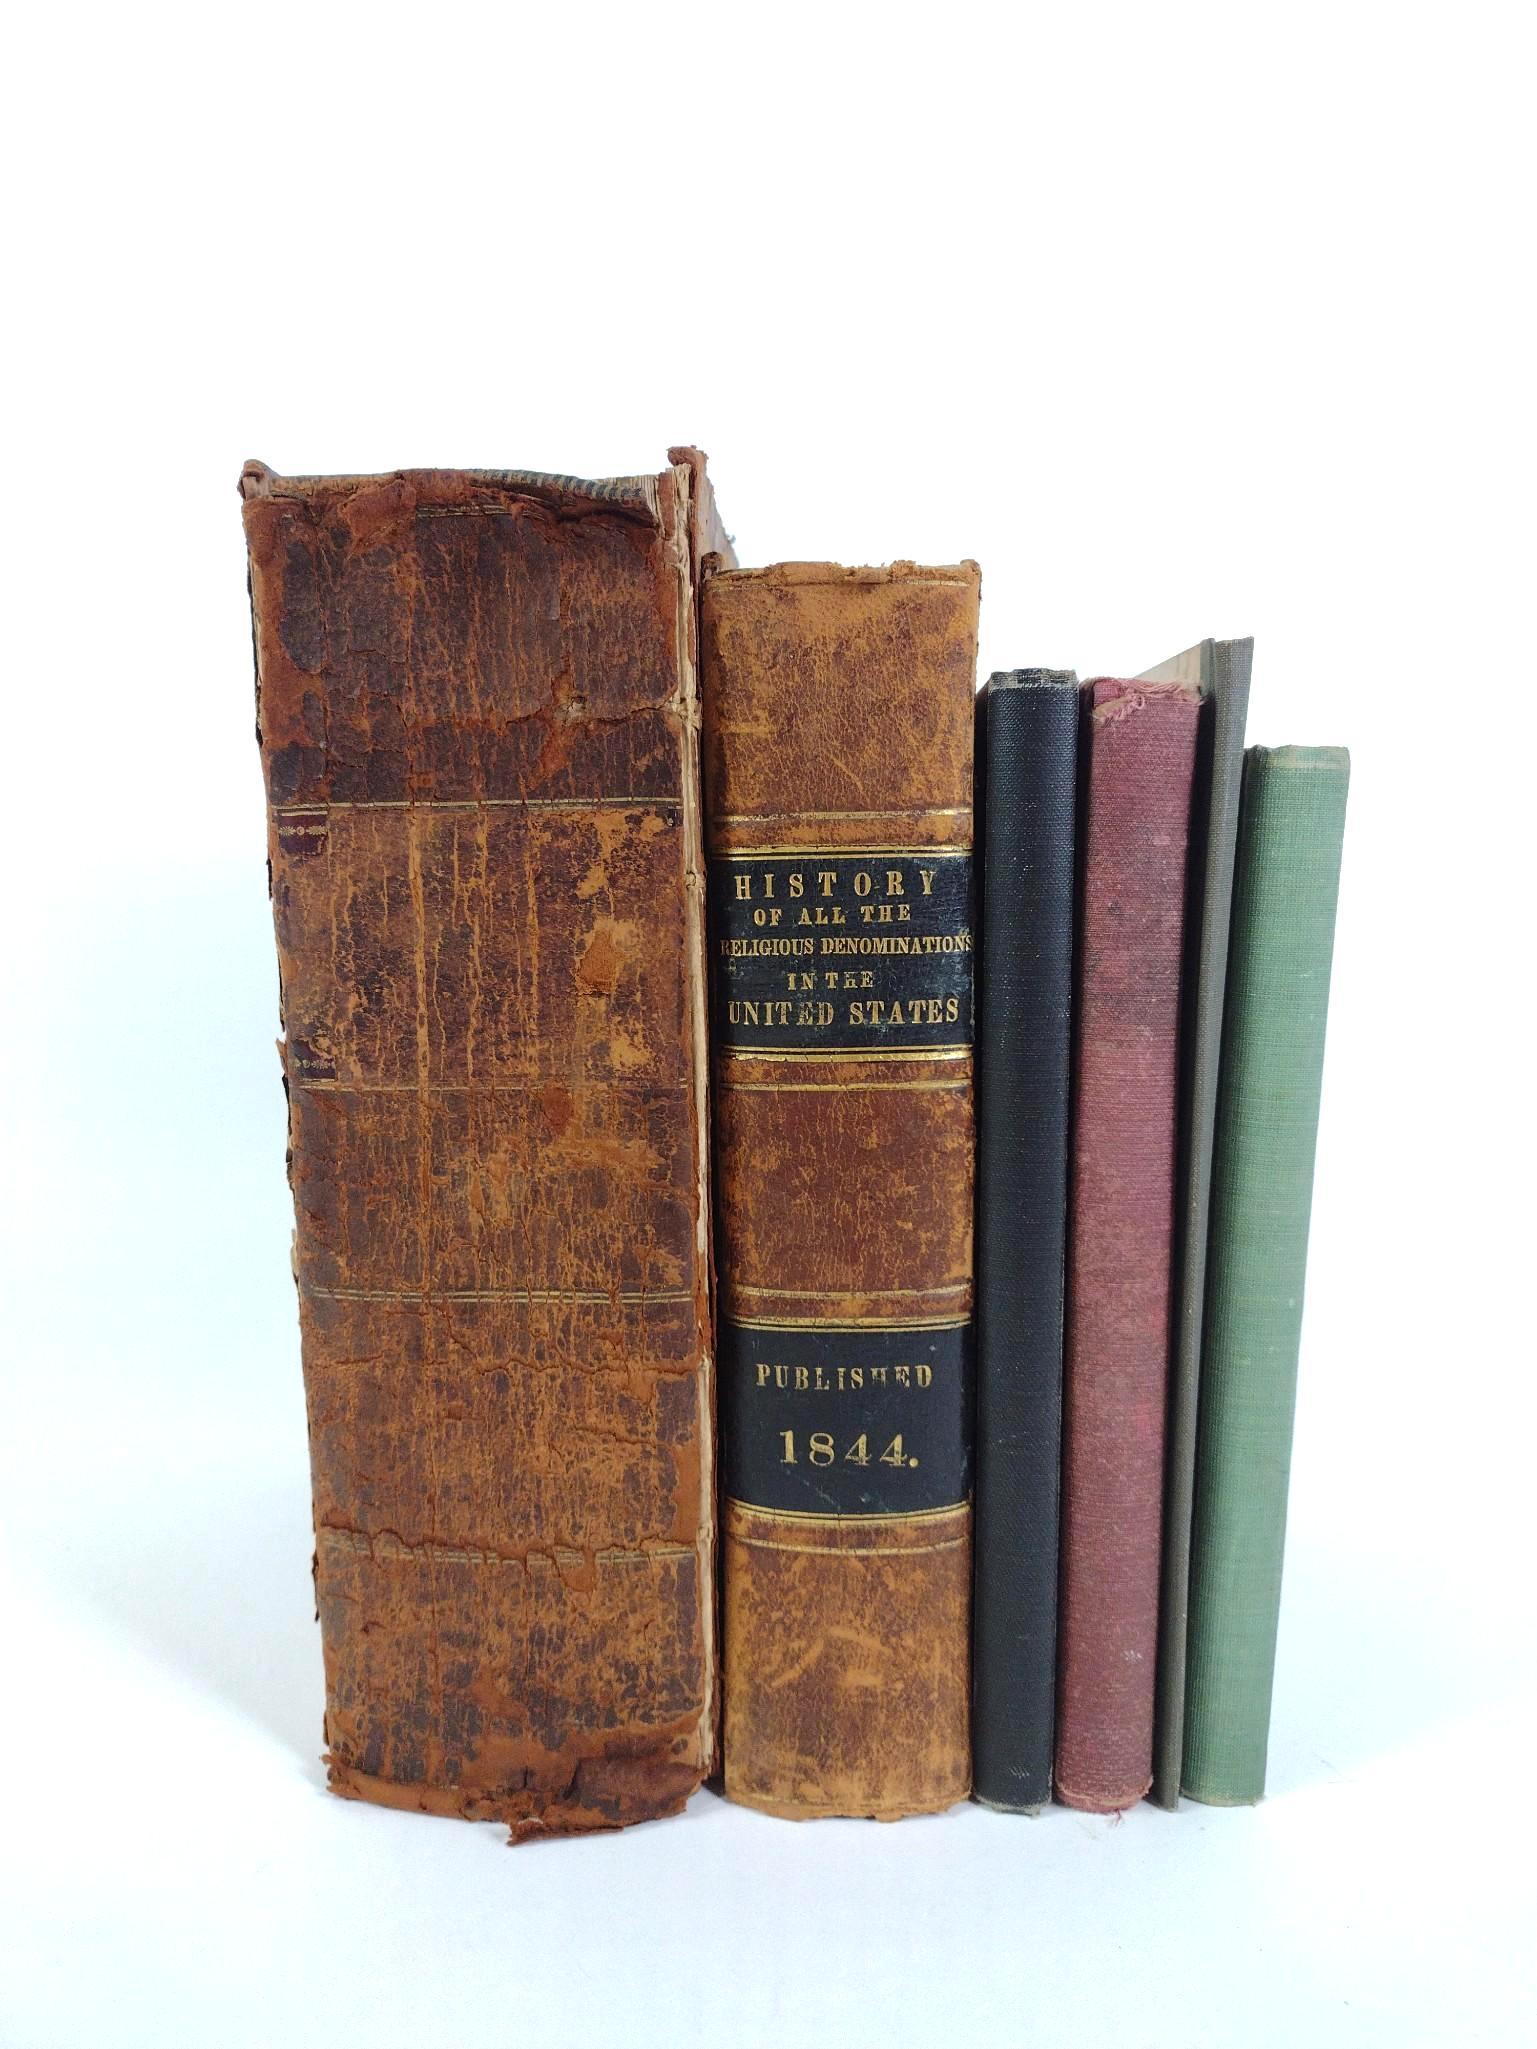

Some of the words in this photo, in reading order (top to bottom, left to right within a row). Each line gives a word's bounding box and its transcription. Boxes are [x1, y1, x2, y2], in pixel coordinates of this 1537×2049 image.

[734, 870, 936, 900] HISTORY
[753, 909, 782, 926] OF
[798, 907, 847, 925] ALL
[861, 904, 910, 922] THE
[720, 938, 814, 956] RELIGIOUS
[820, 934, 974, 955] DENOMINATIONS
[787, 972, 815, 991] IN
[825, 971, 873, 989] THE
[728, 1001, 834, 1026] UNITED
[849, 998, 959, 1025] STATES
[755, 1363, 933, 1391] PUBLISHED
[779, 1430, 919, 1468] 1844.
